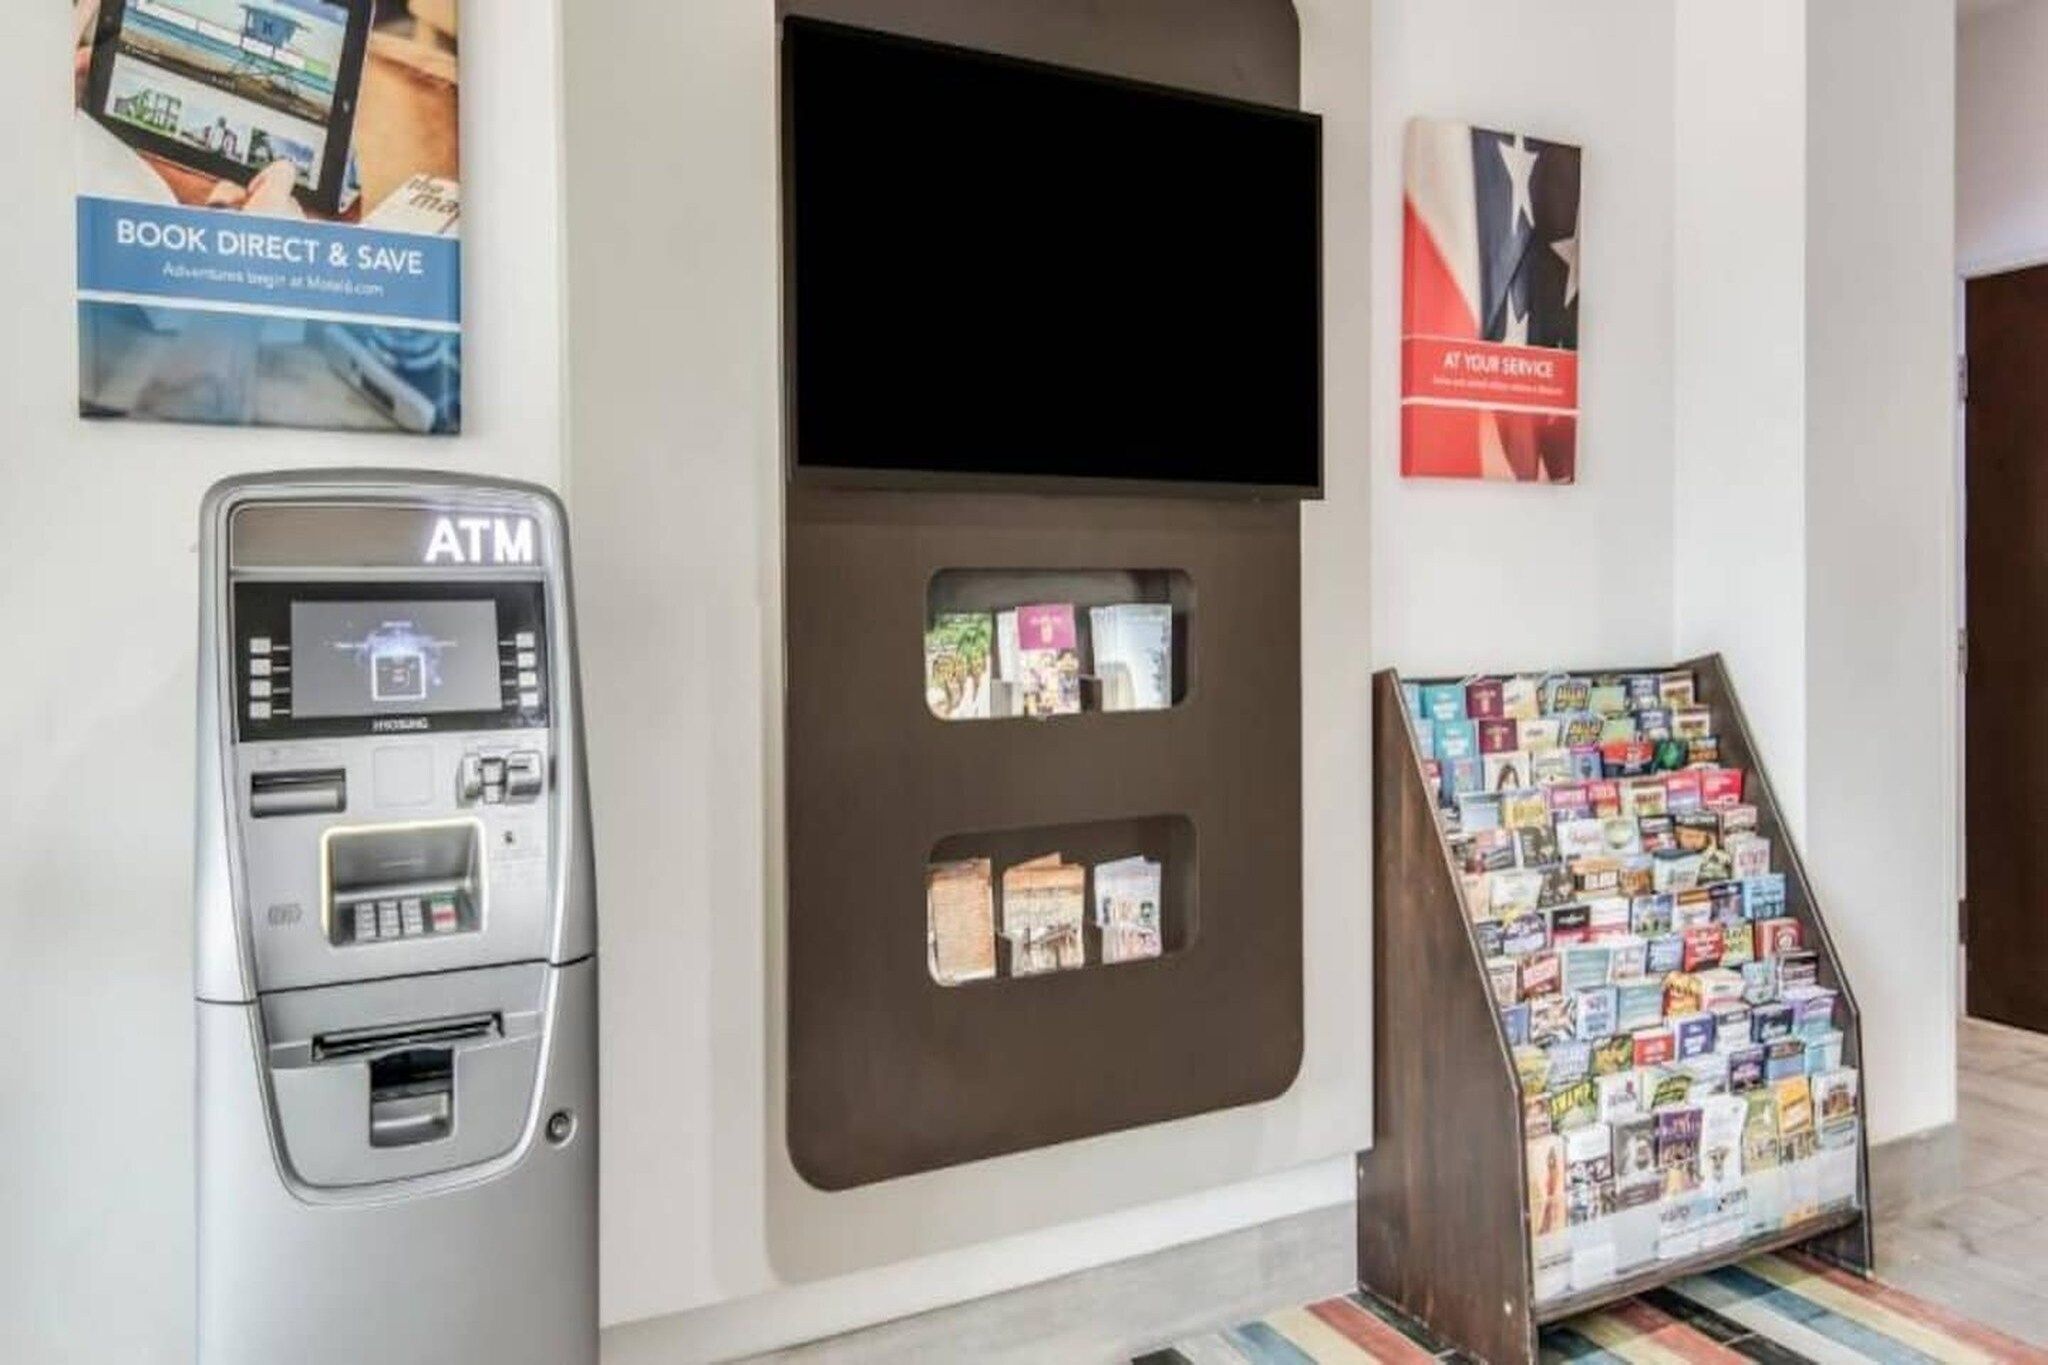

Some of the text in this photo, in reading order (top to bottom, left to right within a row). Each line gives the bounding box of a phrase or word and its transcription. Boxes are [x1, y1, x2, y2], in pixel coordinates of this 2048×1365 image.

[116, 218, 424, 275] BOOK DIRECT & SAVE
[162, 260, 245, 283] Adventures
[1444, 351, 1555, 380] AT YOUR SERVICE
[423, 517, 534, 564] ATM
